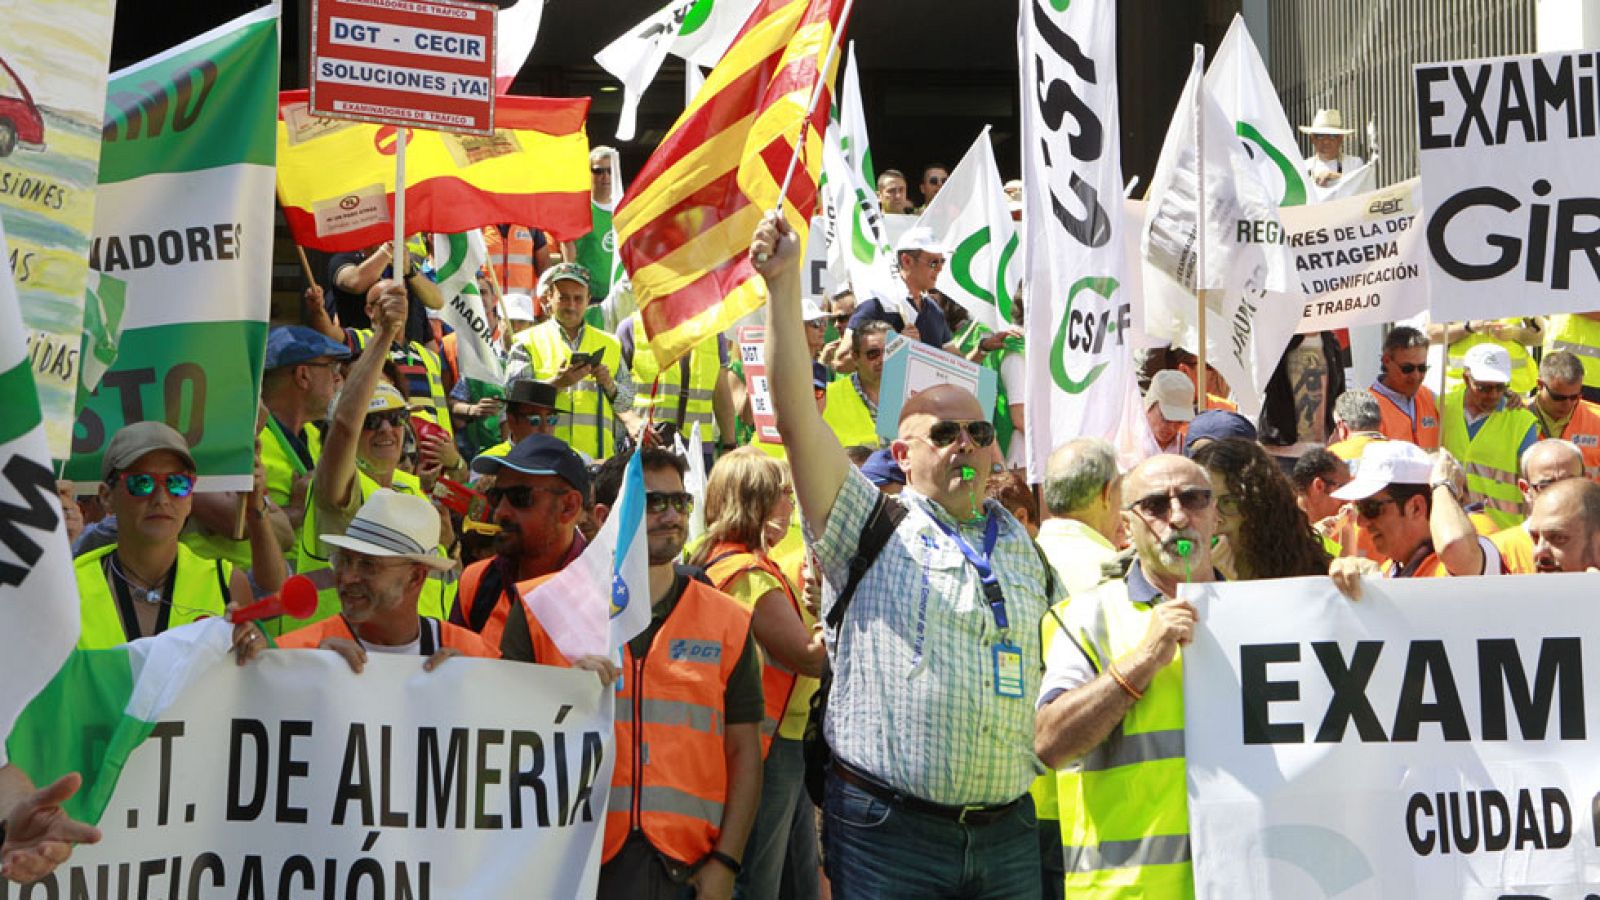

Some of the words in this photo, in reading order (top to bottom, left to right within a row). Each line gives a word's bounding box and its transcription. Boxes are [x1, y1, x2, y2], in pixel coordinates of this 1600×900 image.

[334, 22, 381, 43] DGT
[414, 33, 482, 56] CECIR
[321, 62, 446, 91] SOLUCIONES
[451, 79, 488, 96] ¡YA!
[1415, 53, 1600, 149] EXAMi
[1287, 228, 1329, 248] RES
[1333, 226, 1356, 242] DE
[1360, 223, 1383, 238] LA
[1386, 215, 1415, 233] DGT
[1296, 240, 1399, 271] ARTAGENA
[1313, 262, 1419, 293] DIGNIFICACIÓN
[450, 294, 496, 349] MADR
[1316, 294, 1381, 316] TRABAJO
[690, 646, 722, 658] DGT
[1240, 636, 1587, 746] EXAM
[226, 717, 313, 824] DE
[330, 704, 602, 829] ALMERÍA
[1405, 786, 1572, 857] CIUDAD
